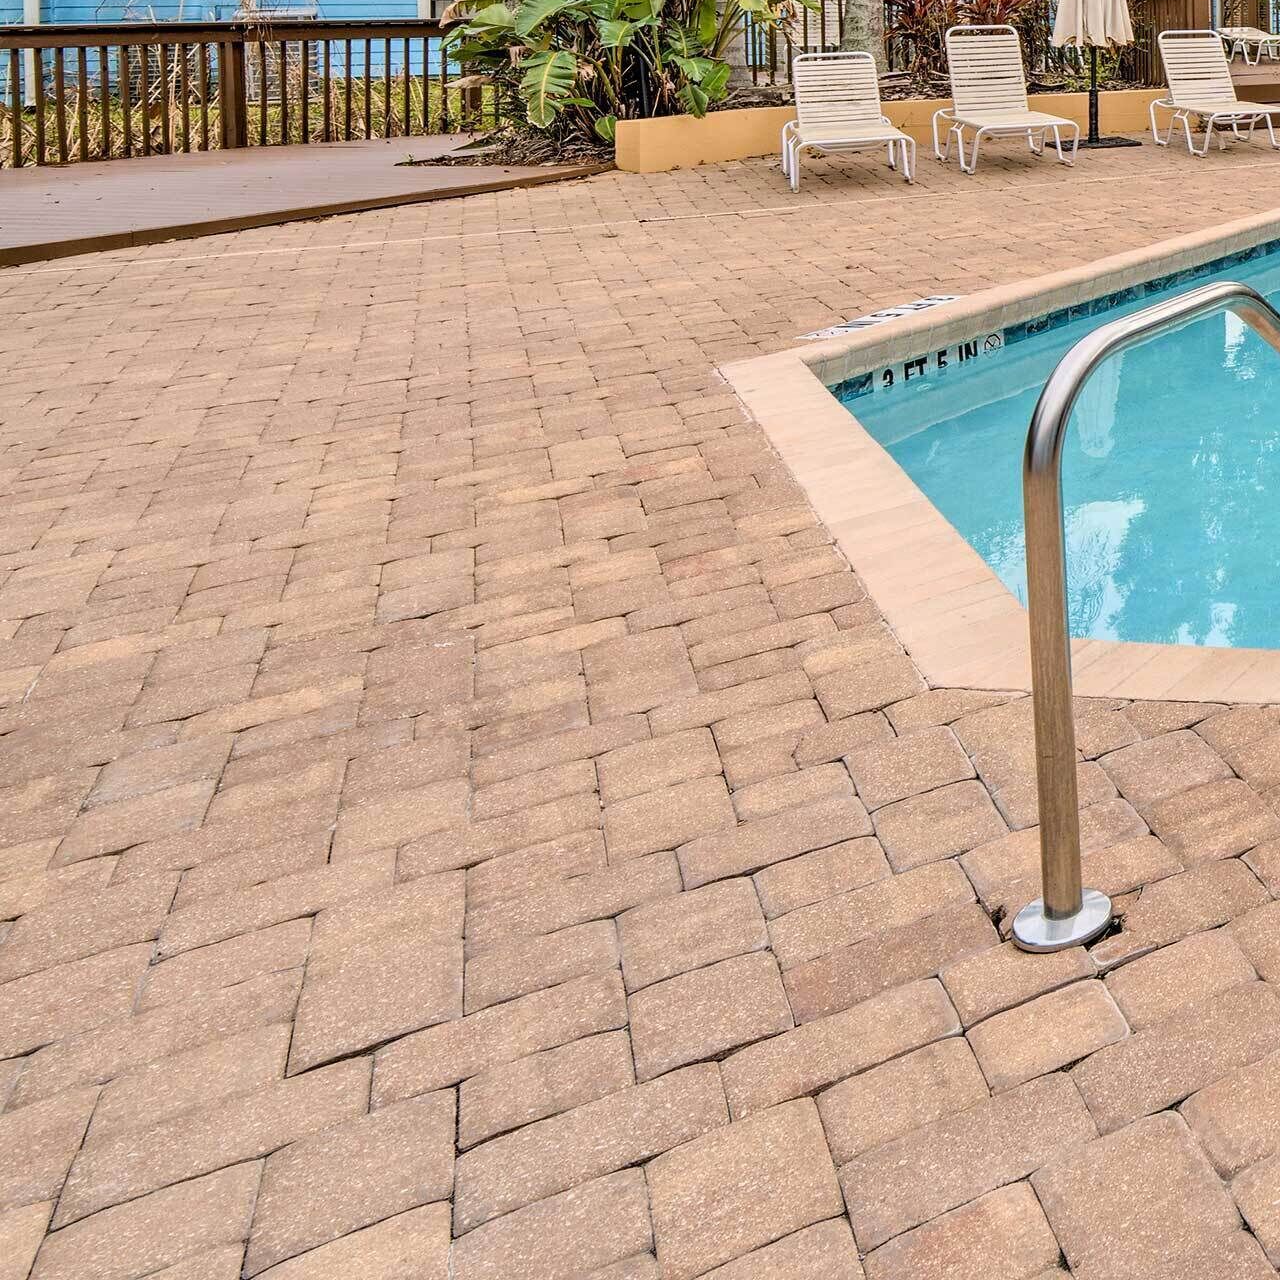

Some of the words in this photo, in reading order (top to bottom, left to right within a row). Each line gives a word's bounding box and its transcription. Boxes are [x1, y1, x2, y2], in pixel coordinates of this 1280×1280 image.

[882, 368, 894, 388] 3
[904, 356, 928, 381] FT
[937, 349, 949, 369] 5
[958, 339, 978, 362] IN
